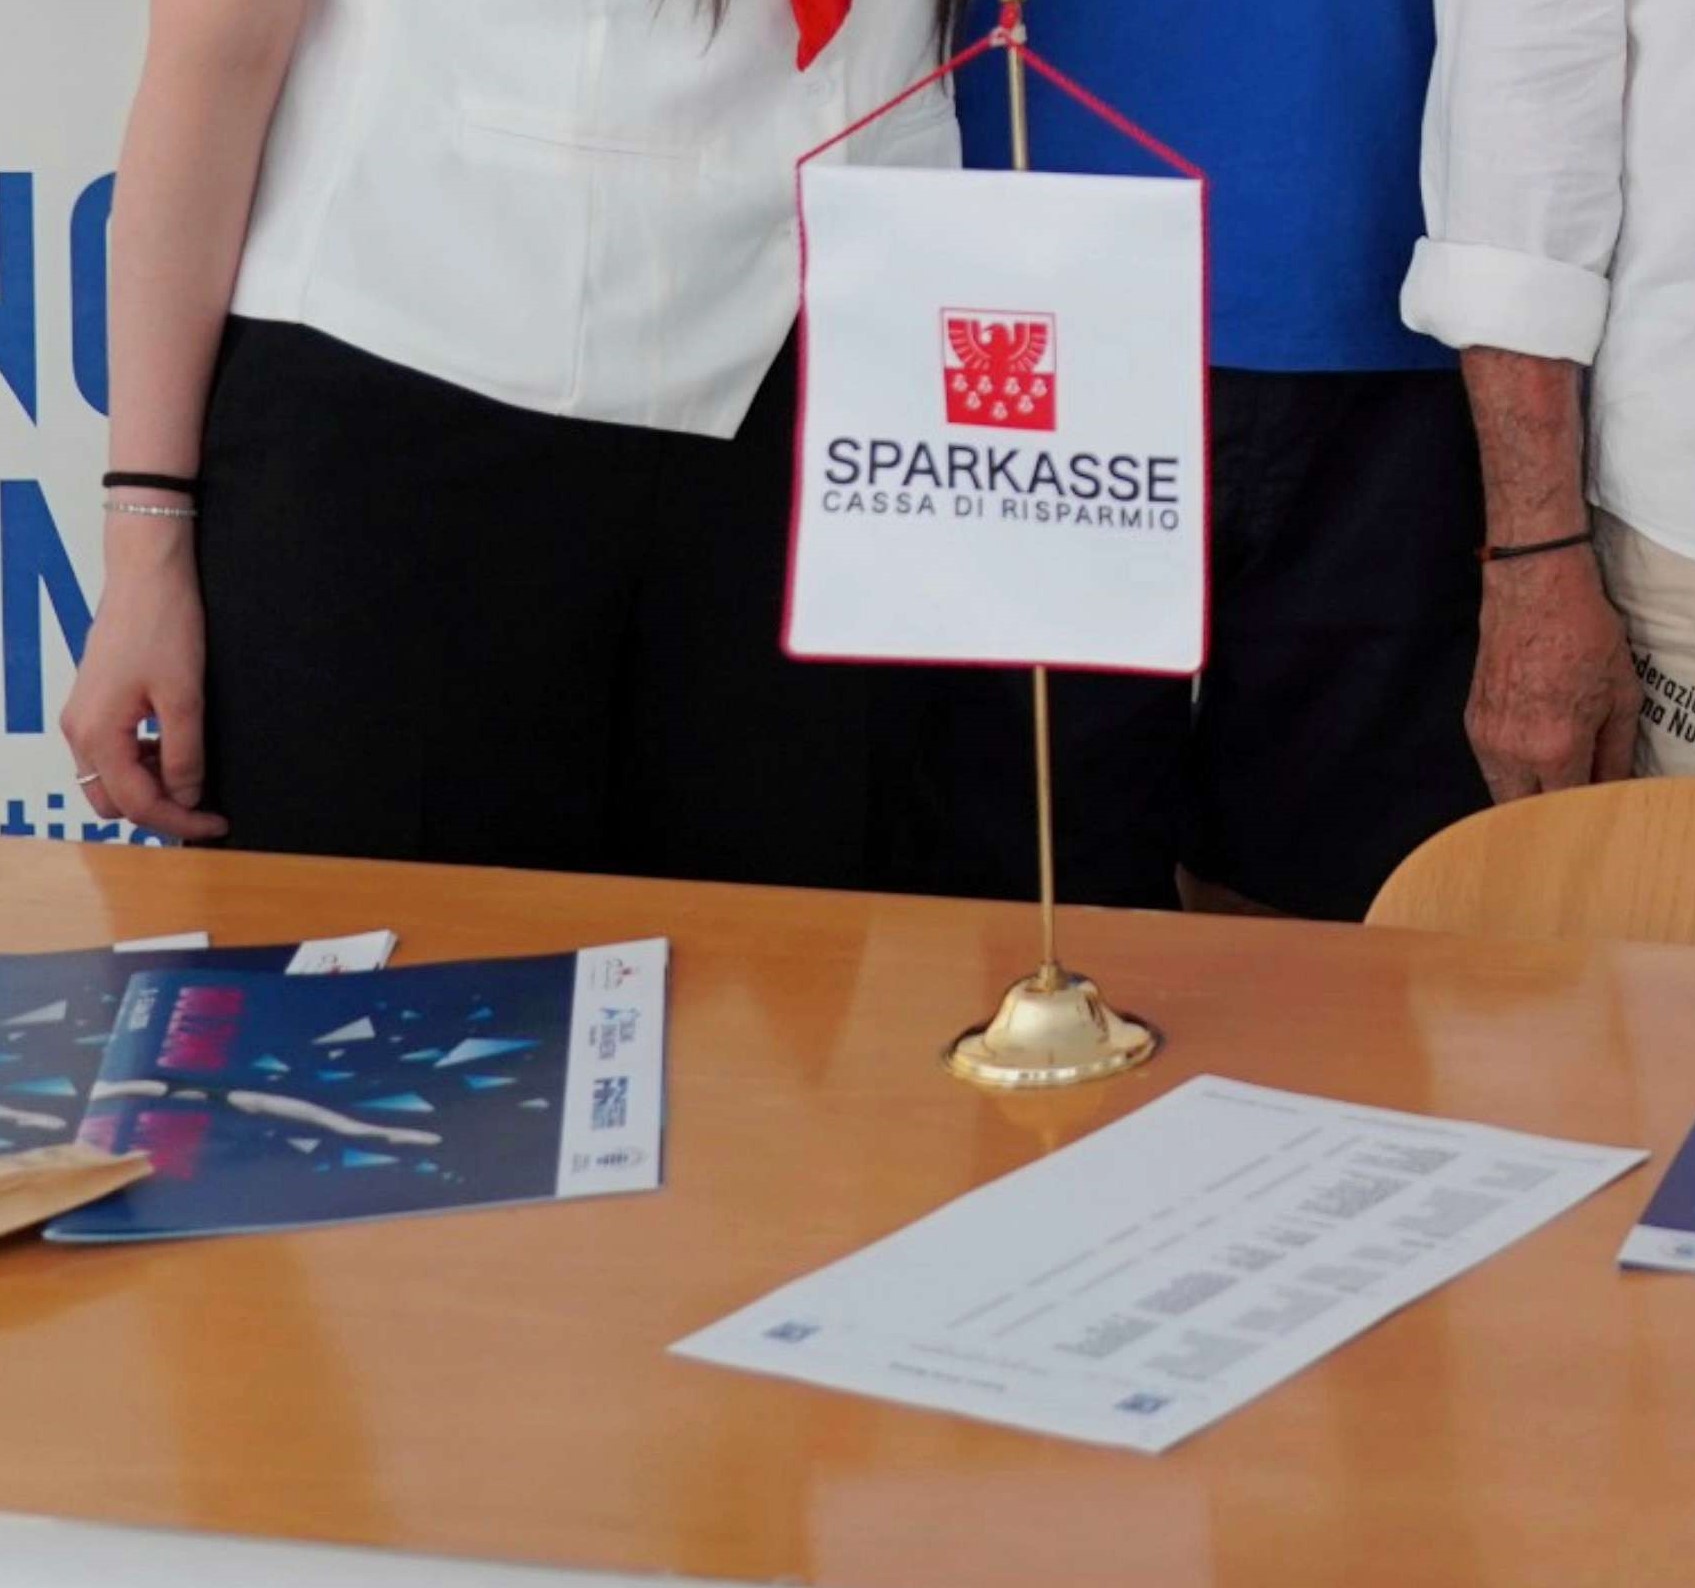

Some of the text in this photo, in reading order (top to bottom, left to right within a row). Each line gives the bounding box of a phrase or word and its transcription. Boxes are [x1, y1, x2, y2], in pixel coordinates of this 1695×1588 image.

[825, 436, 1180, 503] SPARKASSE
[822, 490, 1180, 532] CASSA DI RISPARMIO
